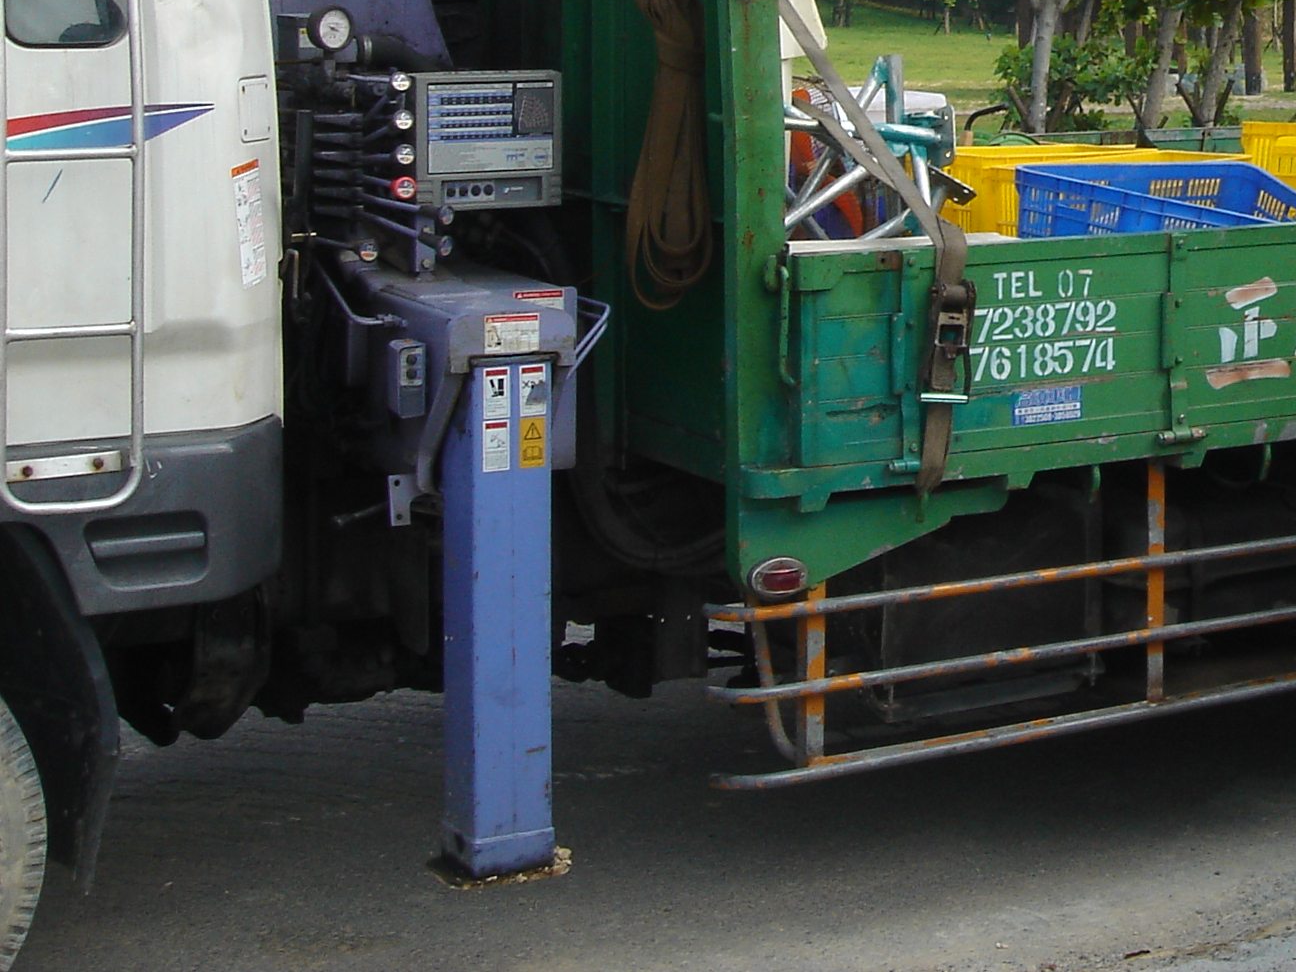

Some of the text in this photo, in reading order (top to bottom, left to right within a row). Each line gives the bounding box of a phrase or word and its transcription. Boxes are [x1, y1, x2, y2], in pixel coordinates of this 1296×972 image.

[993, 269, 1093, 300] TEL 07
[974, 300, 1117, 343] 7238792
[969, 337, 1116, 382] 7618574
